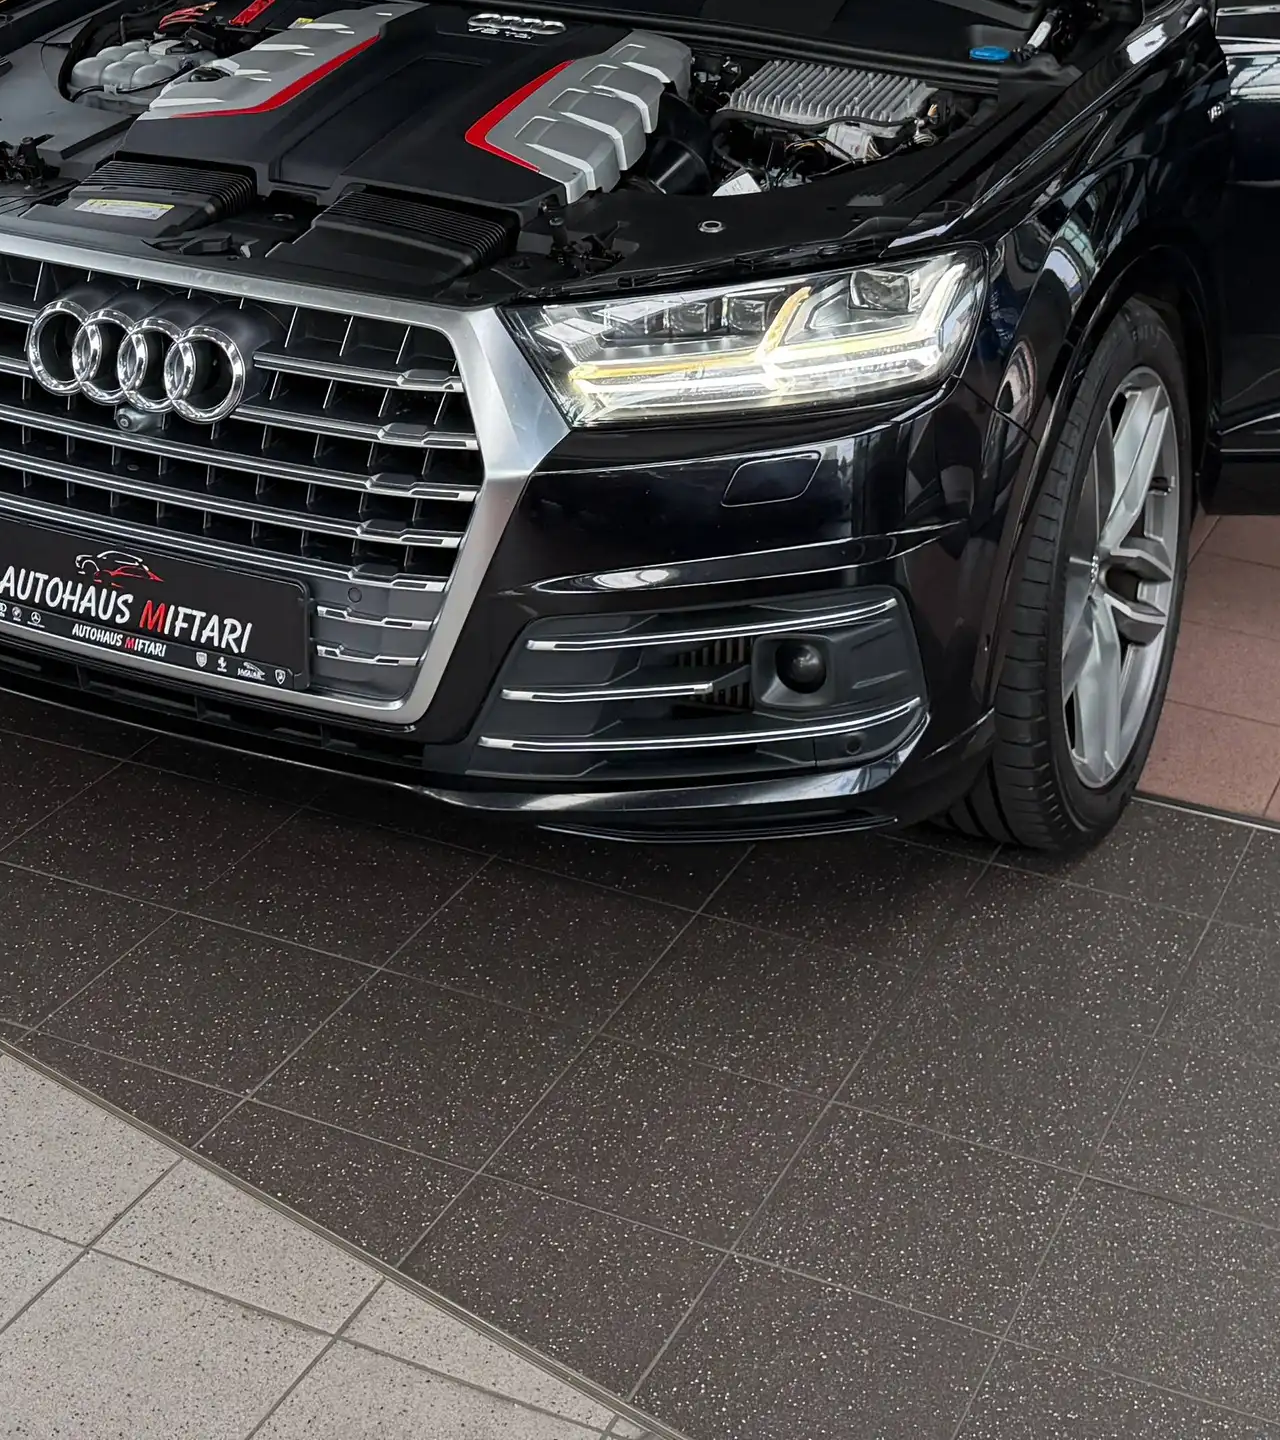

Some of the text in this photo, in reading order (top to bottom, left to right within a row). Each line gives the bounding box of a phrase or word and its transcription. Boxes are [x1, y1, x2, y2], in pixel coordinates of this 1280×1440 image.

[71, 622, 167, 658] AUTOHAUS MIFTARI
[138, 599, 254, 654] MIFTARI
